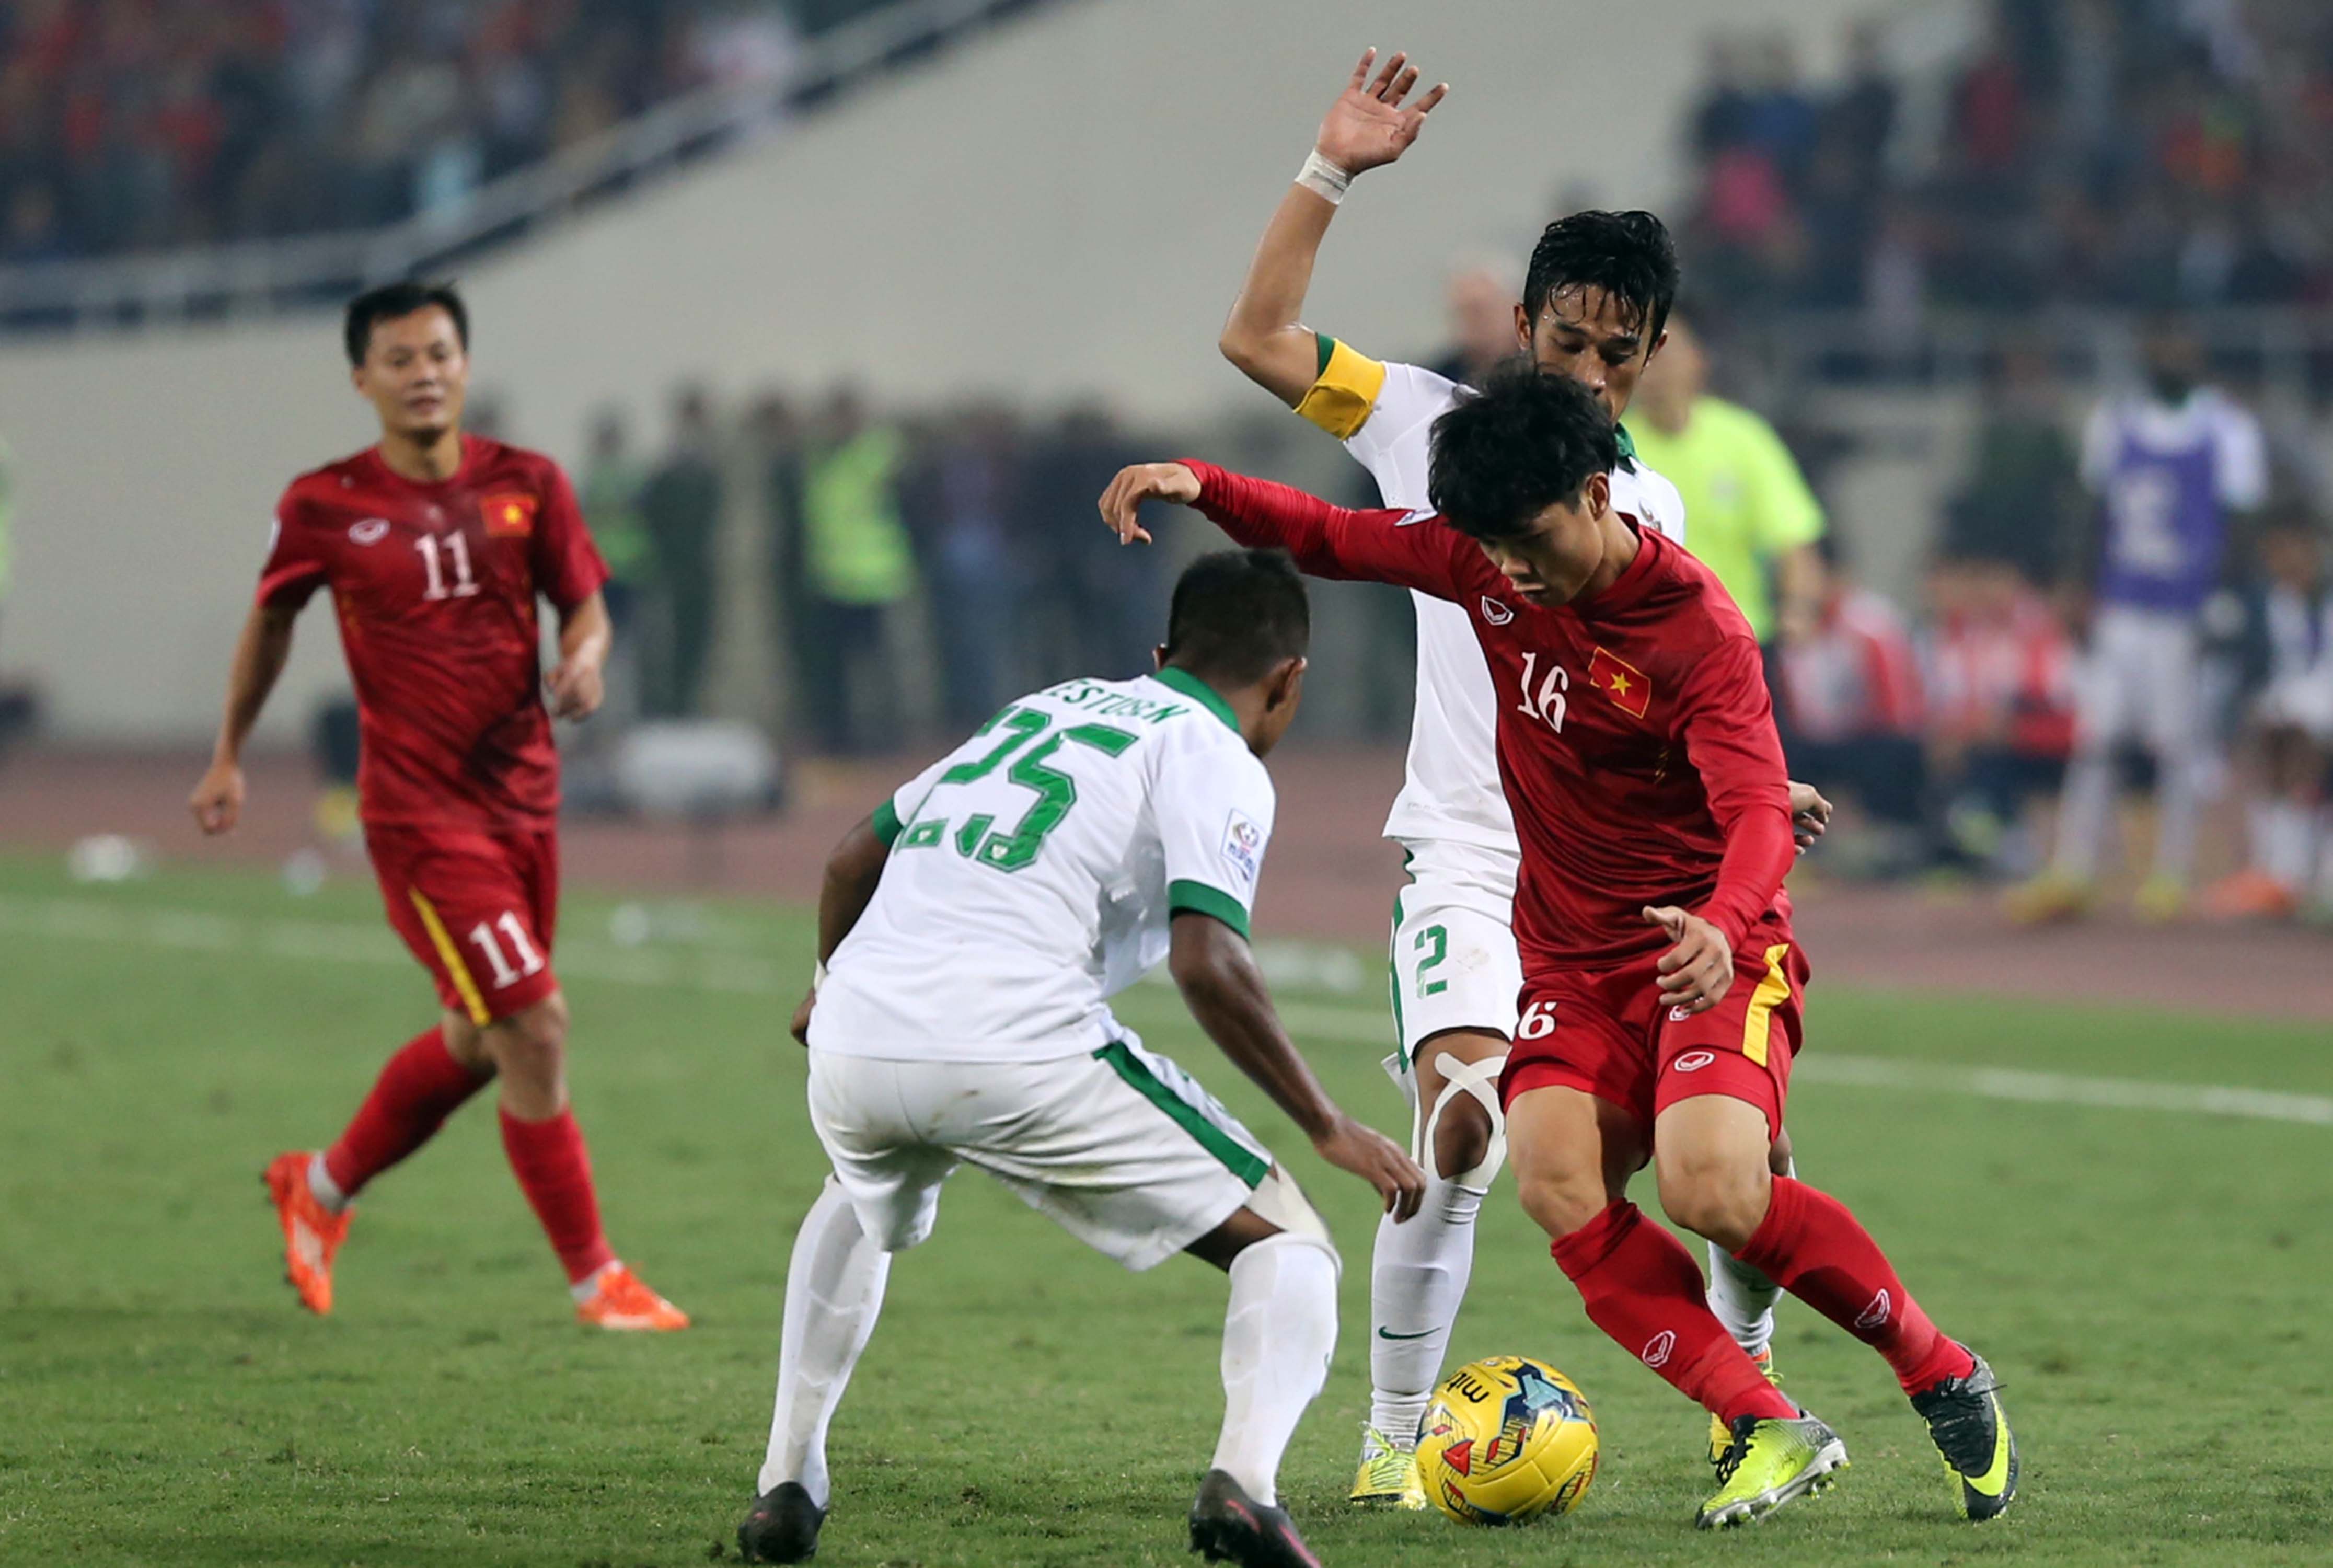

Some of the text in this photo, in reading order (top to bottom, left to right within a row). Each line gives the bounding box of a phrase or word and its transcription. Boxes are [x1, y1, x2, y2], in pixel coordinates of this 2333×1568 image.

[414, 530, 481, 601] 11
[1518, 652, 1568, 733] 16
[894, 706, 1139, 872] 25
[469, 909, 545, 989] 11
[1414, 924, 1447, 1000] 2
[1518, 1001, 1557, 1040] 6
